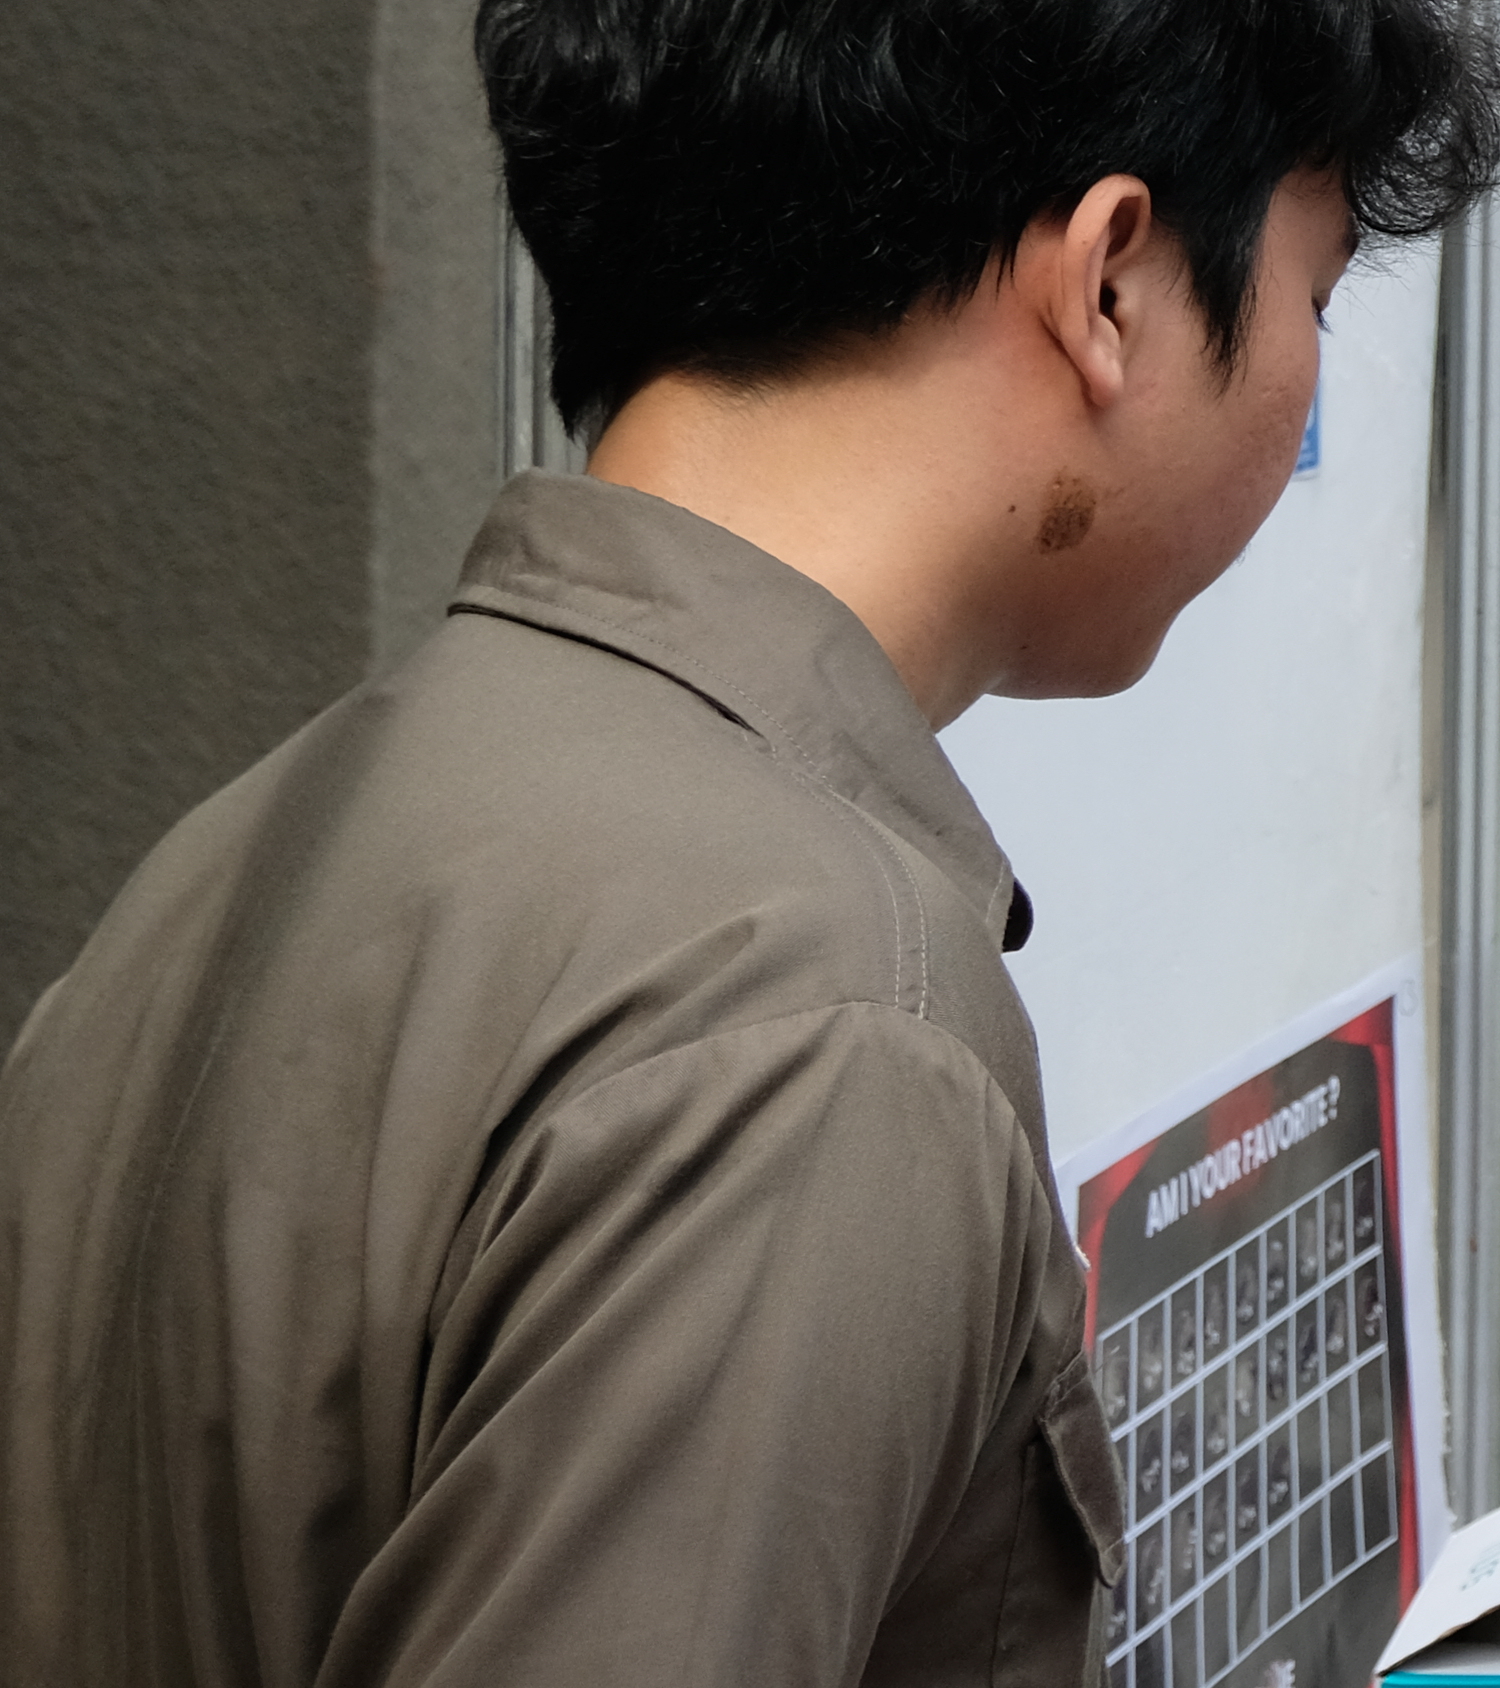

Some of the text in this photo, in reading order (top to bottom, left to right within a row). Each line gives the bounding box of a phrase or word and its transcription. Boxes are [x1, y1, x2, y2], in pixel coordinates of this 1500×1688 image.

[1145, 1177, 1180, 1239] AM
[1179, 1170, 1188, 1216] I
[1188, 1138, 1242, 1209] YOUR
